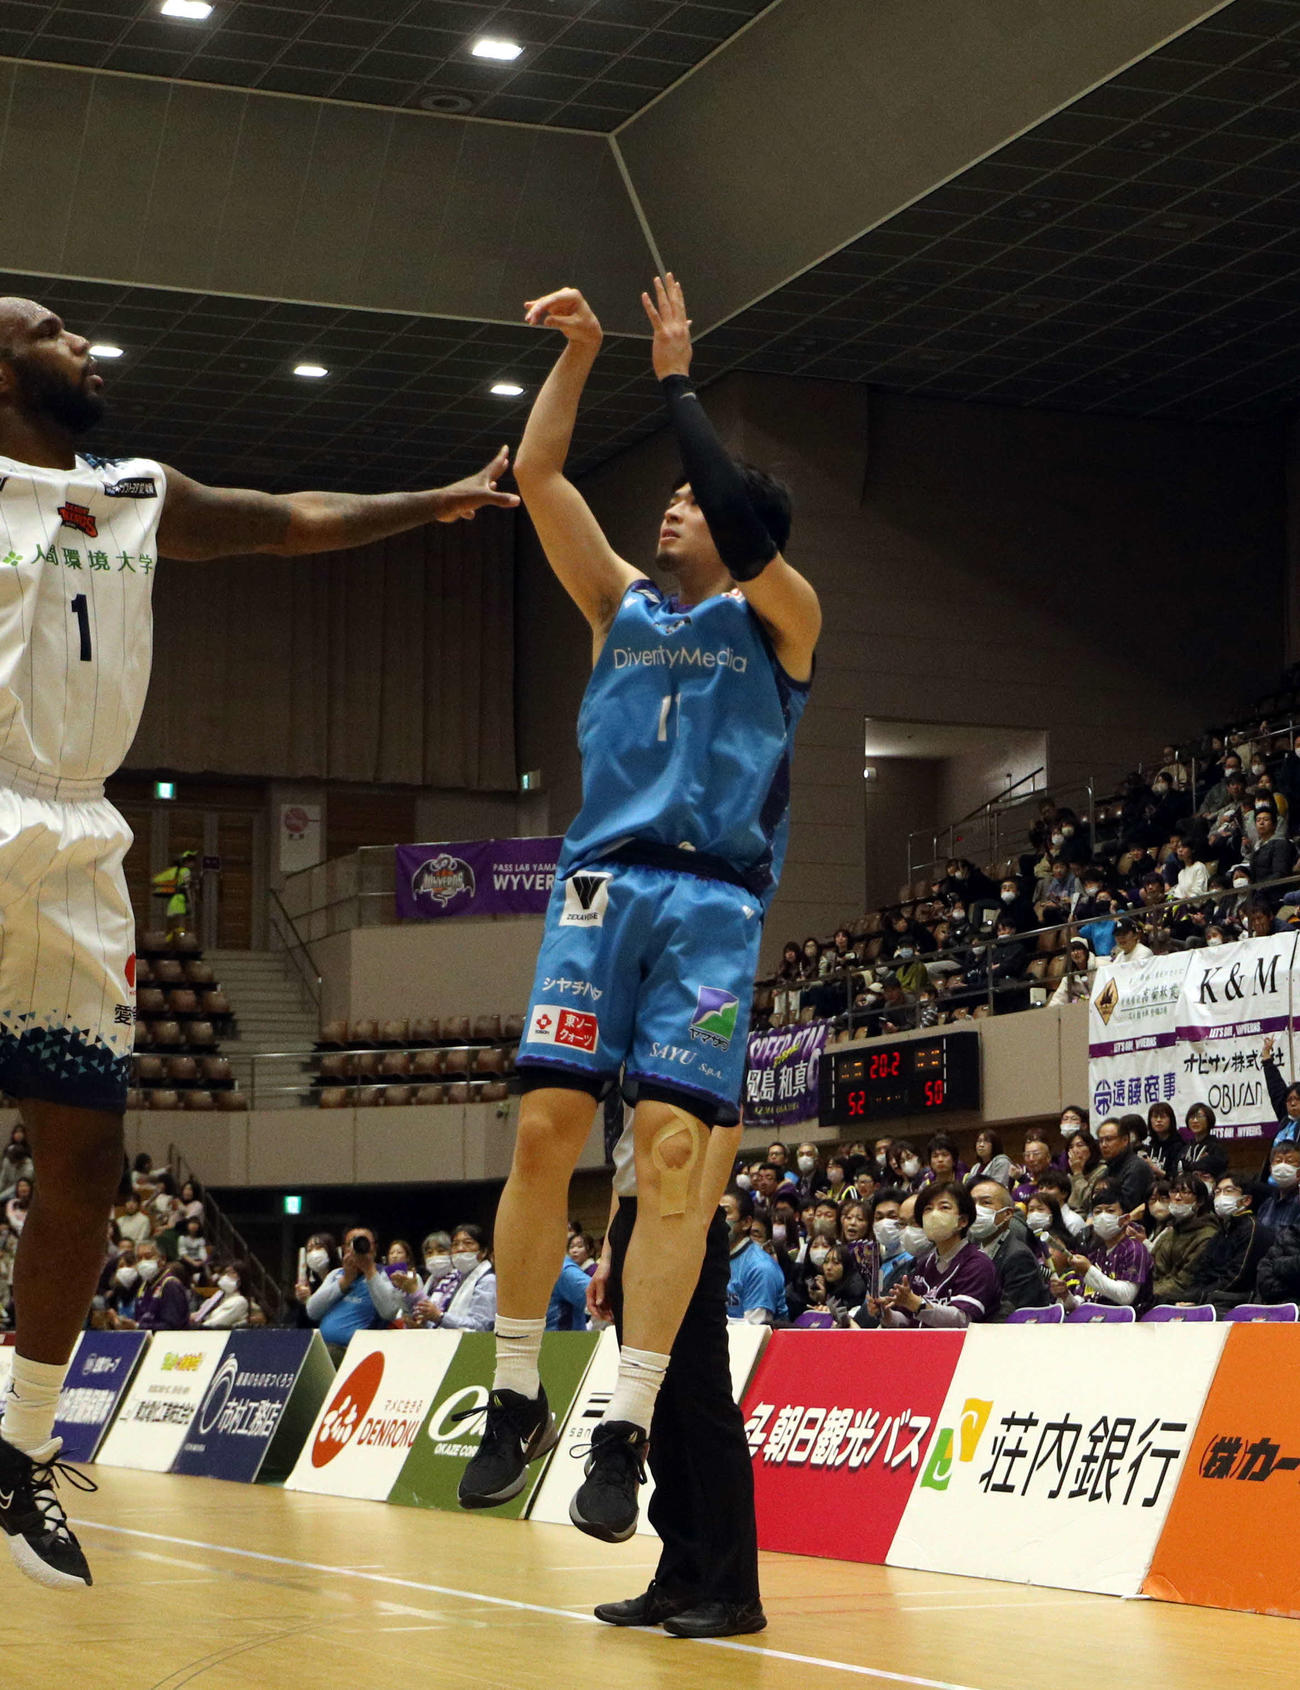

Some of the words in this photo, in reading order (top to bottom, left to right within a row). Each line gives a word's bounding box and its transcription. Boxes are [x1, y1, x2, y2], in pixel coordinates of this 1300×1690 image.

[31, 543, 153, 575] 人間環境大学
[71, 593, 92, 661] 1
[493, 863, 513, 872] PASS
[515, 863, 531, 871] LAB
[1195, 966, 1223, 1005] K
[1224, 962, 1246, 1001] &
[1252, 954, 1281, 997] M
[114, 1003, 137, 1026] 愛
[564, 1014, 593, 1028] 東ソー
[649, 1042, 697, 1065] SAYU
[1184, 1047, 1285, 1075] オビサン株式社
[848, 1090, 865, 1116] 52
[924, 1079, 943, 1106] 50
[1113, 1072, 1176, 1107] 遠藤商事
[217, 1397, 282, 1437] 市村工務店
[356, 1418, 419, 1448] DENROKU
[979, 1411, 1188, 1508] 荘内銀行
